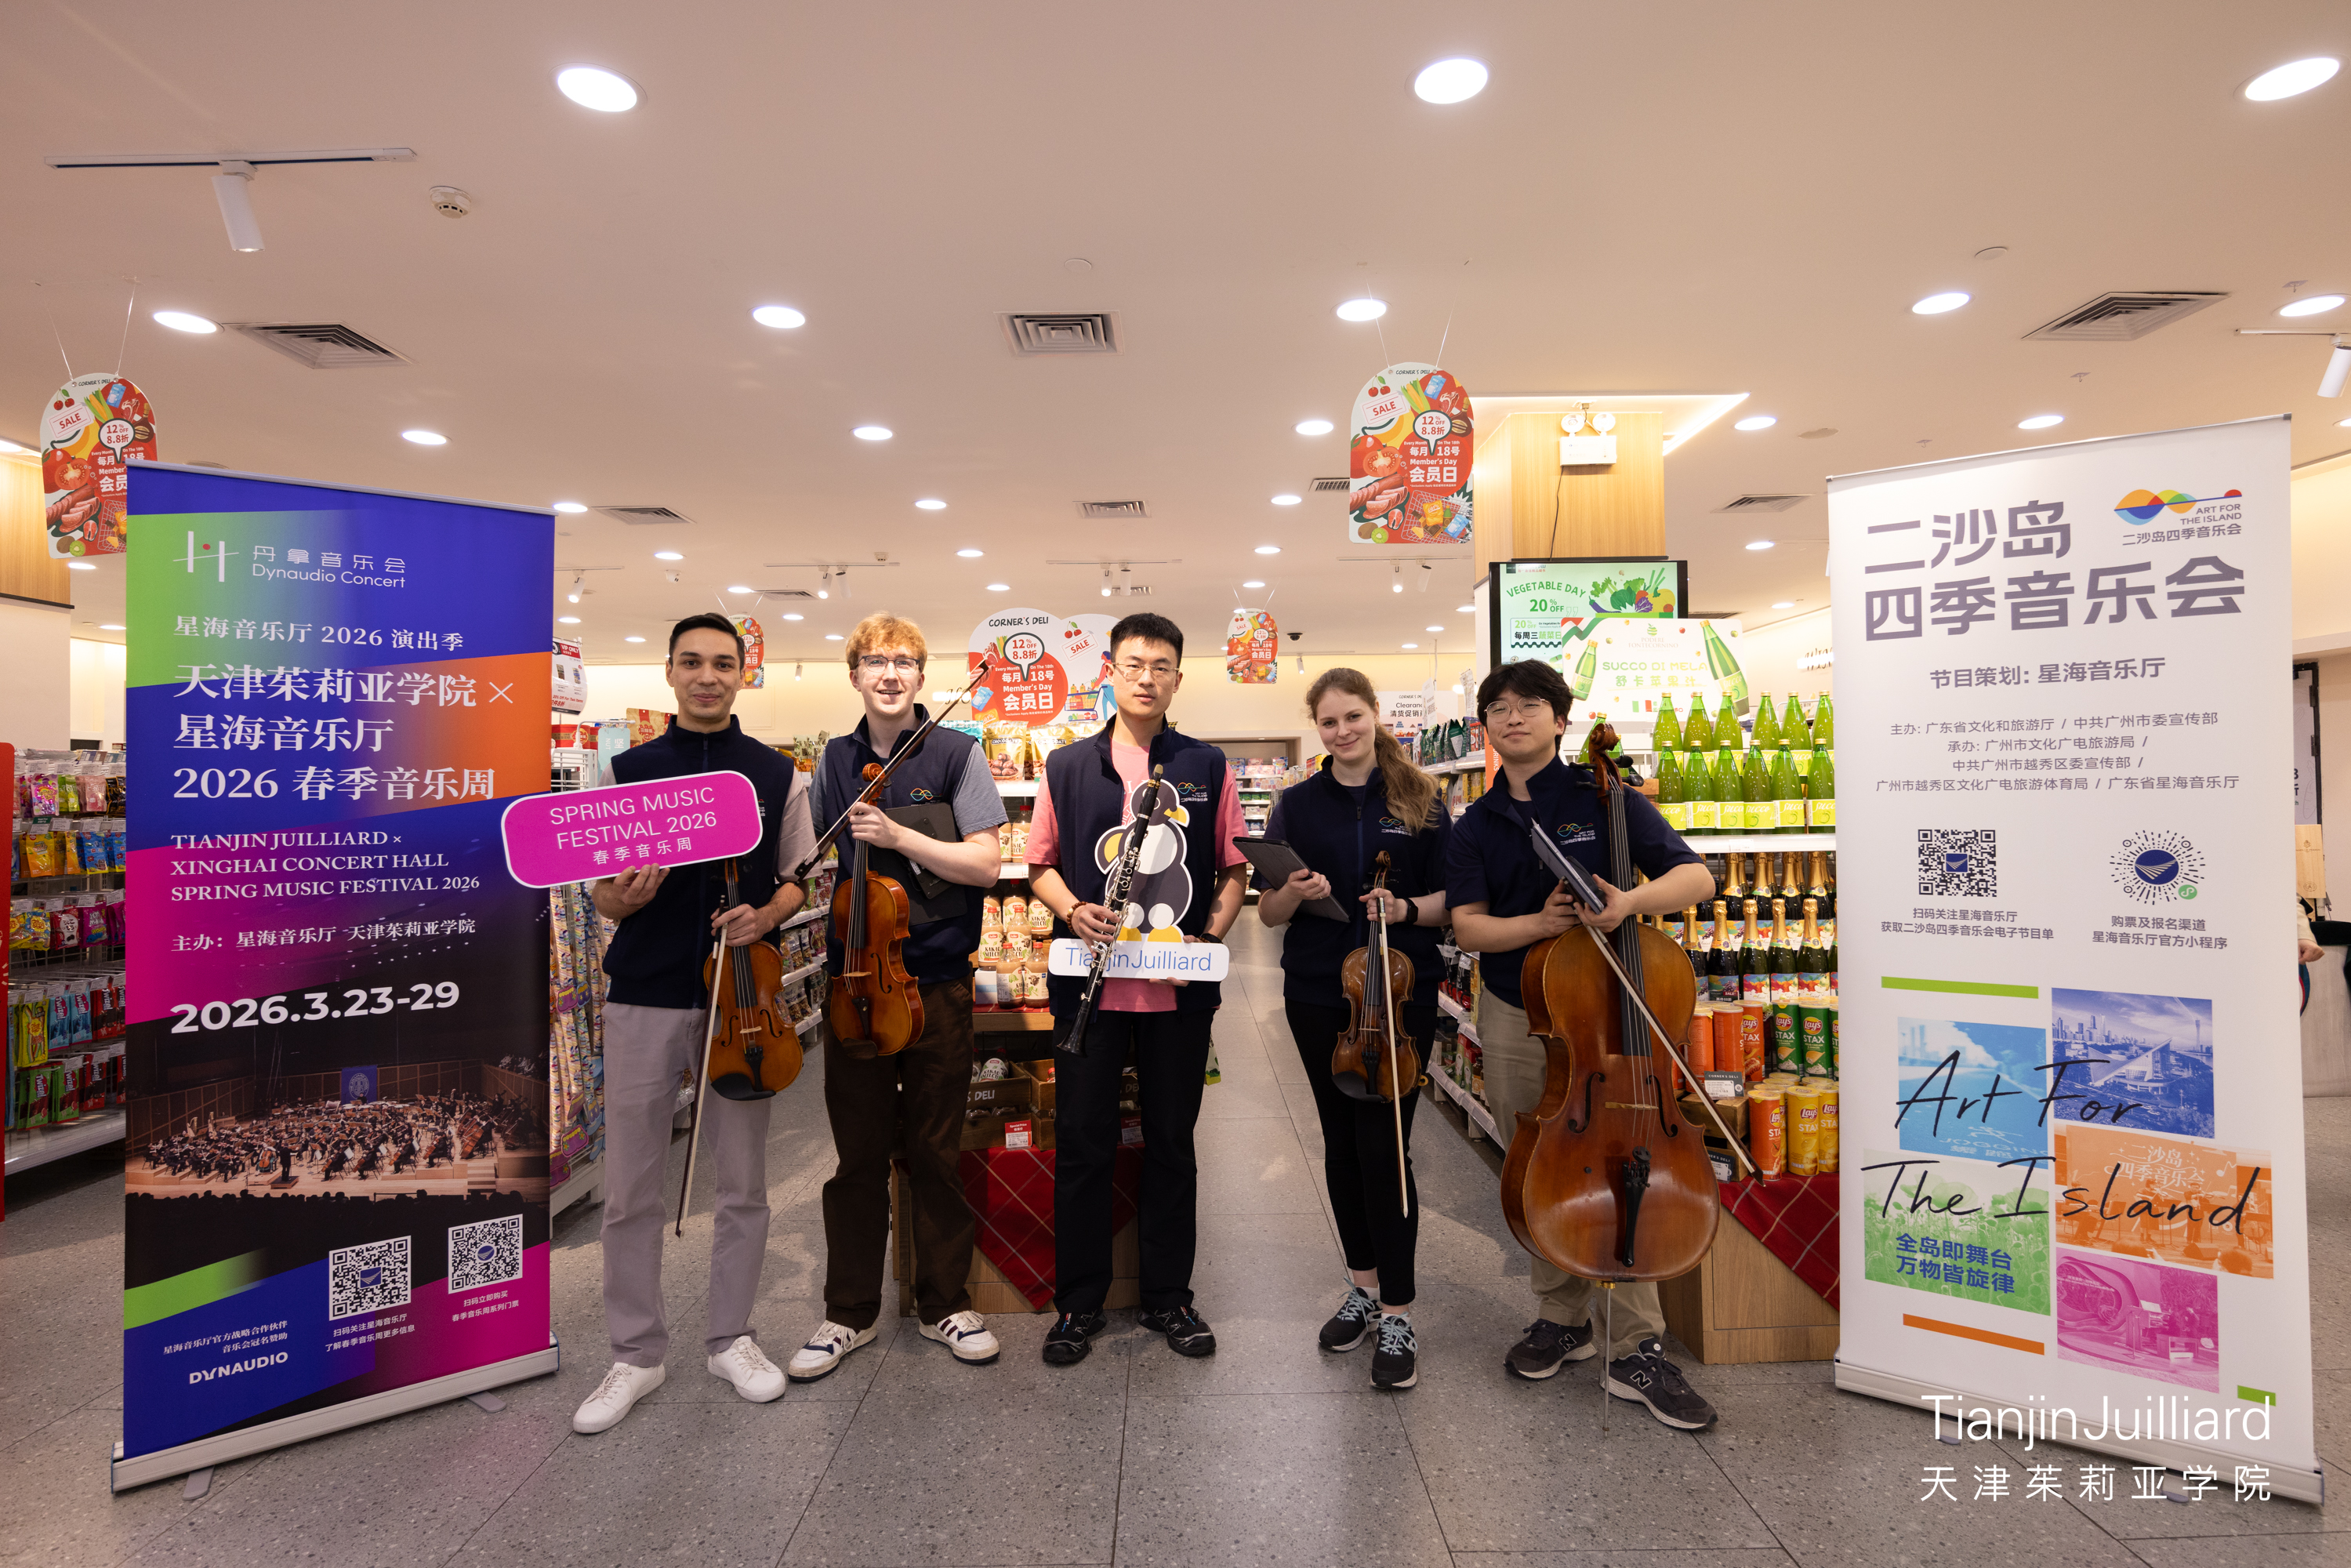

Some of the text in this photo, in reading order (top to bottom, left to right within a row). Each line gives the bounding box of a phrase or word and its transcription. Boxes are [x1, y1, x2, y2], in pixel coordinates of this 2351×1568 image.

[1373, 401, 1396, 416] SALE
[59, 412, 82, 430] SALE
[106, 424, 118, 434] 12
[1421, 416, 1434, 425] 12
[107, 434, 129, 444] 8.8折
[1421, 426, 1445, 435] 8.8折
[1410, 447, 1428, 456] 每月
[1437, 446, 1460, 456] 18号
[97, 455, 114, 466] 每月
[1410, 466, 1457, 483] 会员日
[2196, 504, 2241, 515] ART FOR
[2180, 513, 2242, 525] THE ISLAND
[1865, 499, 2071, 575] 二沙岛
[2122, 523, 2243, 546] 二沙岛四季音乐会
[252, 545, 406, 574] 丹拿音乐会
[252, 563, 406, 588] Dynaudio Concert
[1506, 581, 1587, 598] VEGETABLE DAY
[1865, 555, 2246, 642] 四季音乐会
[1529, 599, 1547, 612] 20
[989, 616, 1049, 627] CORNER'S DELI
[173, 615, 464, 652] 星海音乐厅 2026 演出季
[1515, 631, 1561, 640] 每周三蔬菜日
[1012, 639, 1025, 649] 12
[1070, 640, 1090, 654] SALE
[1012, 650, 1037, 659] 8.8折
[1030, 670, 1054, 681] 18号
[1602, 662, 1708, 671] SUCCO DI MELA
[173, 662, 477, 708] 天津茱莉亚学院
[1002, 673, 1021, 683] 每月
[1615, 675, 1696, 687] 舒卡苹果汁
[1003, 692, 1054, 711] 会员日
[2073, 712, 2219, 730] 中共广州市委宣传部
[173, 713, 395, 753] 星海音乐厅
[1952, 755, 2132, 772] 中共广州市越秀区委宣传部
[172, 764, 496, 800] 2026 春季音乐周
[1875, 776, 2089, 793] 广州市越秀区文化广电旅游体育局
[2107, 775, 2240, 791] 广东省星海音乐厅
[550, 786, 716, 826] SPRING MUSIC
[557, 811, 717, 850] FESTIVAL 2026
[170, 833, 268, 852] TIANJIN
[270, 830, 389, 851] JUILLIARD
[593, 837, 693, 866] 春季音乐周
[169, 852, 450, 877] XINGHAI CONCERT HALL
[170, 875, 481, 902] SPRING MUSIC FESTIVAL 2026
[1912, 907, 2019, 923] 扫码关注星海音乐厅
[2110, 915, 2207, 932] 购票及报名渠道
[347, 918, 477, 942] 天津茱莉亚学院
[1881, 921, 2055, 940] 获取二沙岛四季音乐会电子节目单
[2092, 931, 2229, 950] 星海音乐厅官方小程序
[1065, 947, 1211, 972] TiajinJuilliard
[170, 980, 460, 1035] 2026.3.23-29
[1776, 1016, 1792, 1028] Lay's
[1805, 1021, 1821, 1031] Lay's
[1775, 1030, 1795, 1040] STAX
[1803, 1035, 1825, 1044] STAX
[974, 1090, 996, 1101] DELI
[1894, 1050, 2143, 1138] Art For
[2130, 1144, 2184, 1170] 二沙岛
[1860, 1160, 1983, 1219] The
[1896, 1232, 2013, 1272] 全岛即舞台
[1896, 1255, 2015, 1294] 万物皆旋律
[463, 1290, 509, 1308] 扫码立即购买
[452, 1299, 520, 1323] 春季音乐周系列门票
[332, 1312, 408, 1338] 扫码关注星海音乐厅
[163, 1319, 288, 1356] 星海音乐厅官方战略合作伙伴
[222, 1332, 288, 1354] 音乐会冠名赞助
[325, 1323, 416, 1352] 了解春季音乐周更多信息
[189, 1352, 288, 1385] DYNAUDIO
